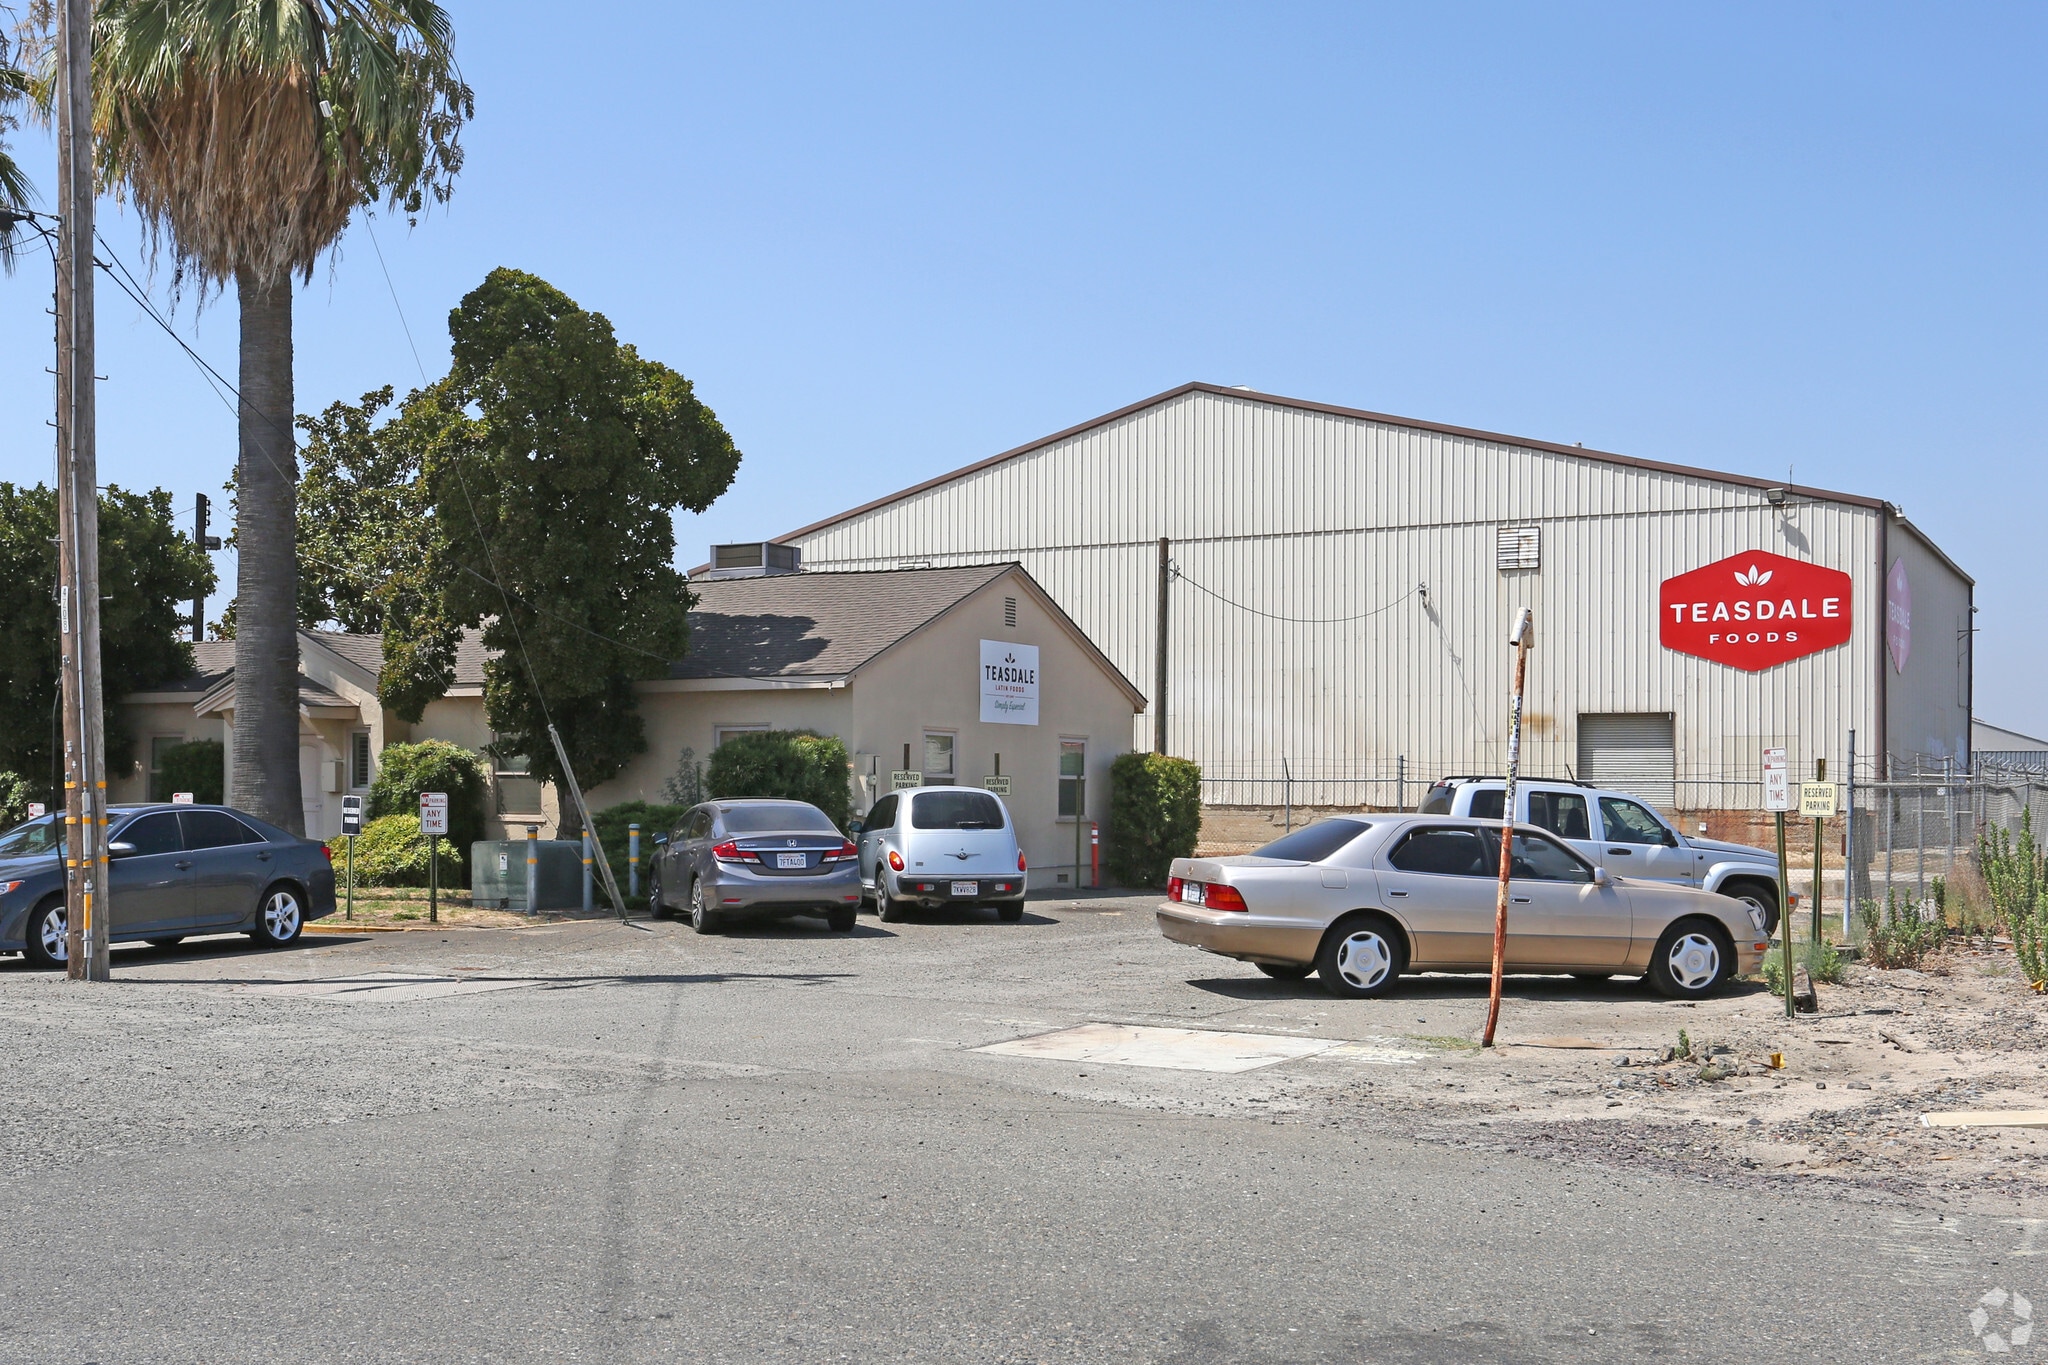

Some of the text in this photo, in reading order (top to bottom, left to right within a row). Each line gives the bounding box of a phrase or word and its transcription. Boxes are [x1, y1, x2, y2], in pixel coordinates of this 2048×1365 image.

[1669, 597, 1840, 624] TEASDALE
[1709, 631, 1798, 645] FOODS
[985, 665, 1035, 685] TEASDALE
[893, 773, 920, 781] RESERVED
[1769, 774, 1783, 785] ANY
[1768, 789, 1785, 801] TIME
[1803, 787, 1833, 798] RESERVED
[1805, 800, 1831, 811] PARKING
[426, 809, 441, 818] ANY
[425, 820, 442, 828] TIME
